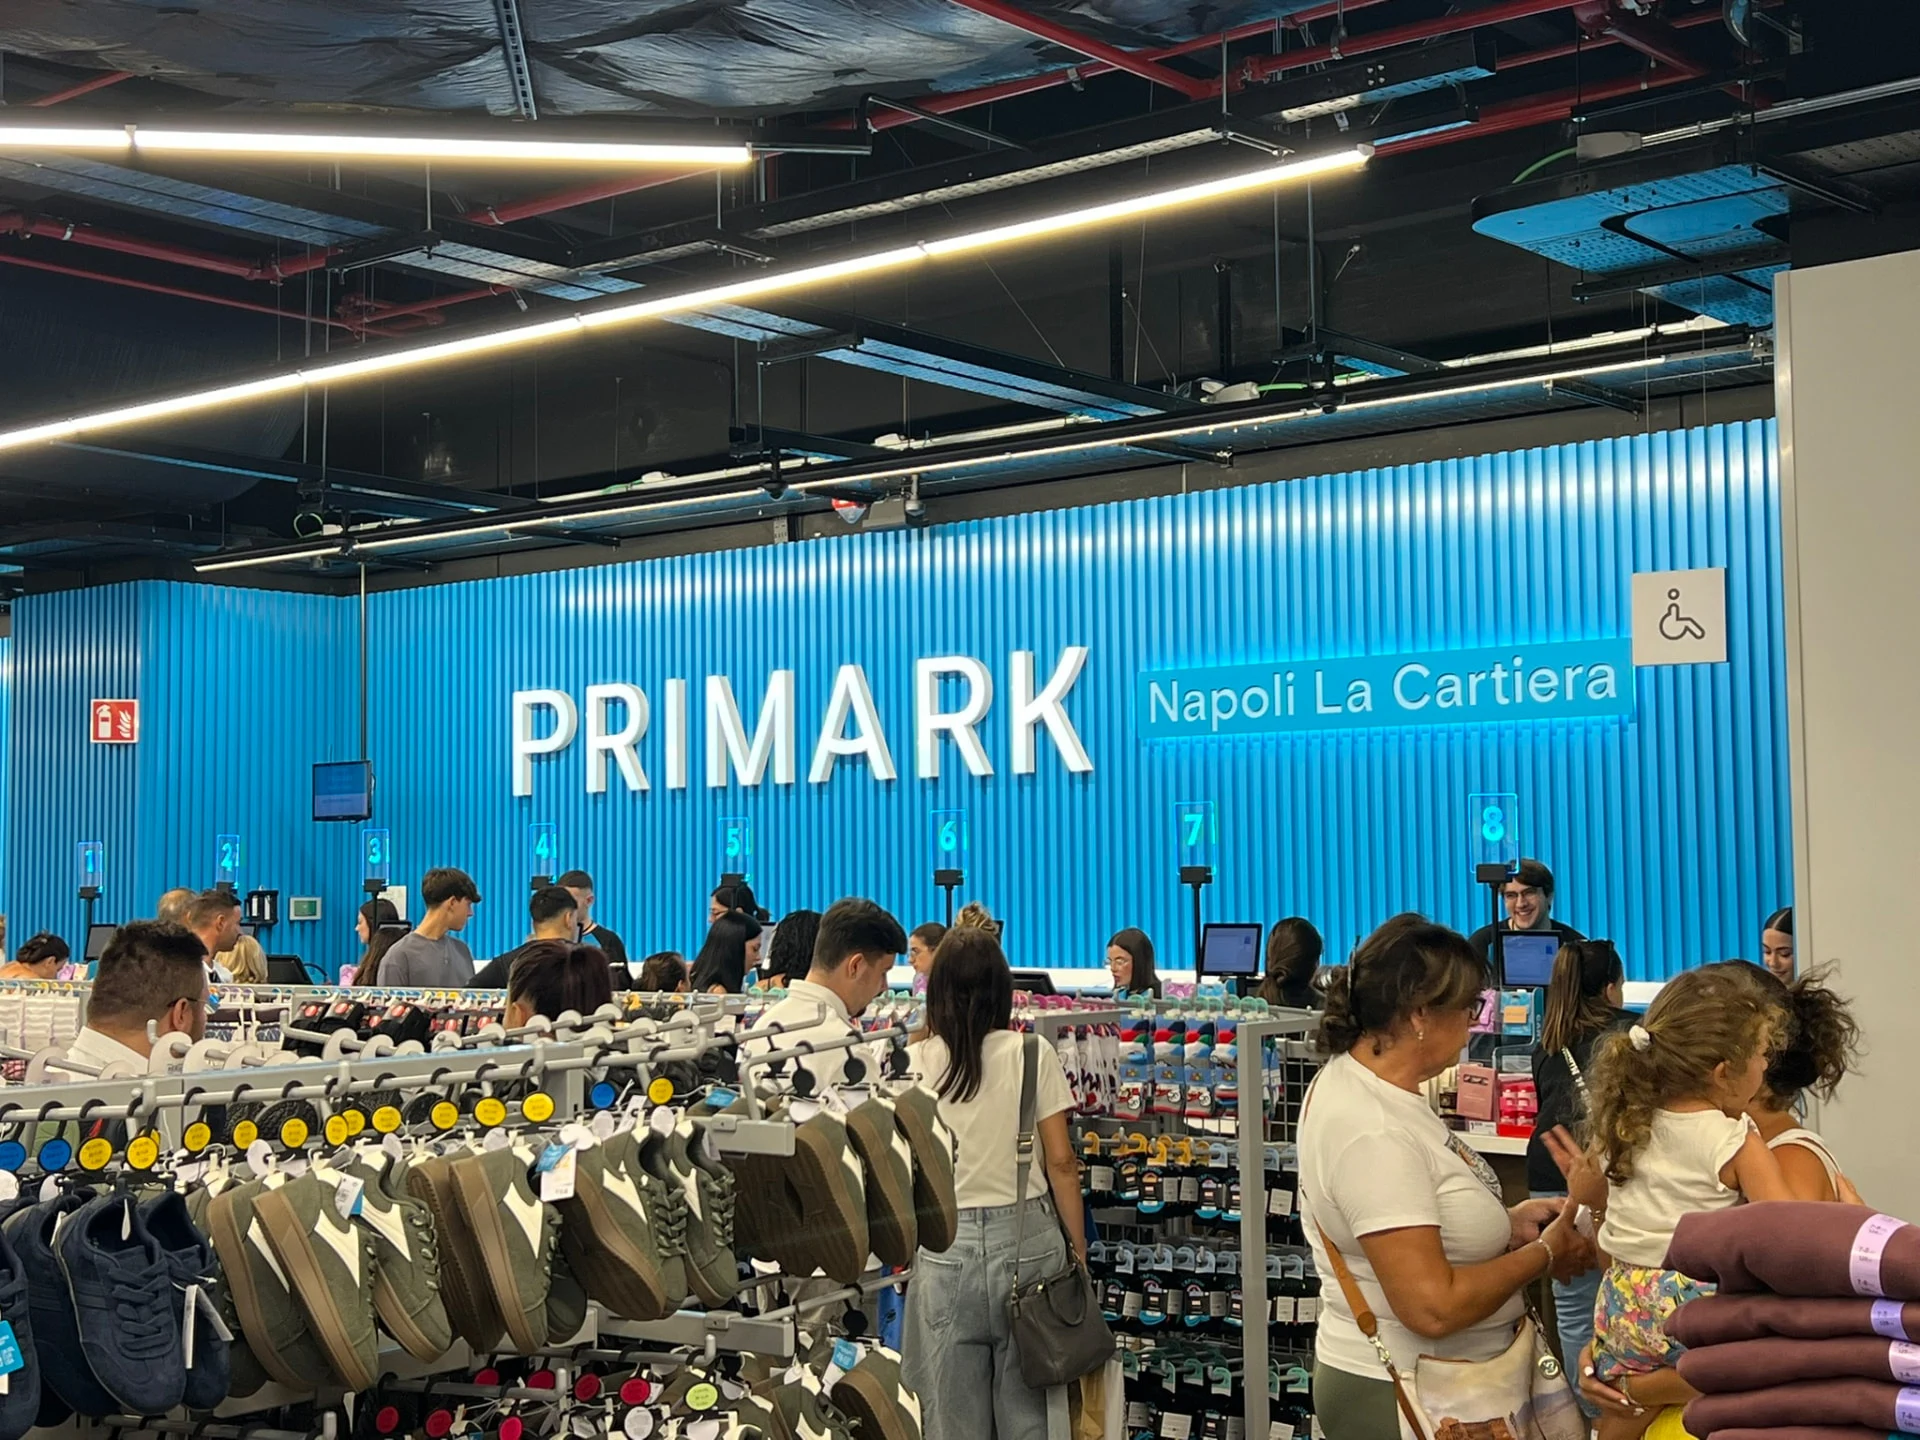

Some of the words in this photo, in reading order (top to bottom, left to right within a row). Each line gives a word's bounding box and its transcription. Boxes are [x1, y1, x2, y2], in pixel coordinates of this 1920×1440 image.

[1148, 671, 1295, 732] Napoli
[1315, 670, 1373, 714] La
[1393, 656, 1617, 711] Cartiera
[512, 646, 1093, 797] PRIMARK
[940, 821, 957, 851] 6
[1184, 814, 1203, 846] 7
[1482, 806, 1505, 841] 8
[221, 842, 233, 872] 2
[368, 838, 381, 864] 3
[536, 833, 549, 859] 4
[726, 828, 741, 858] 5
[85, 850, 94, 873] 1
